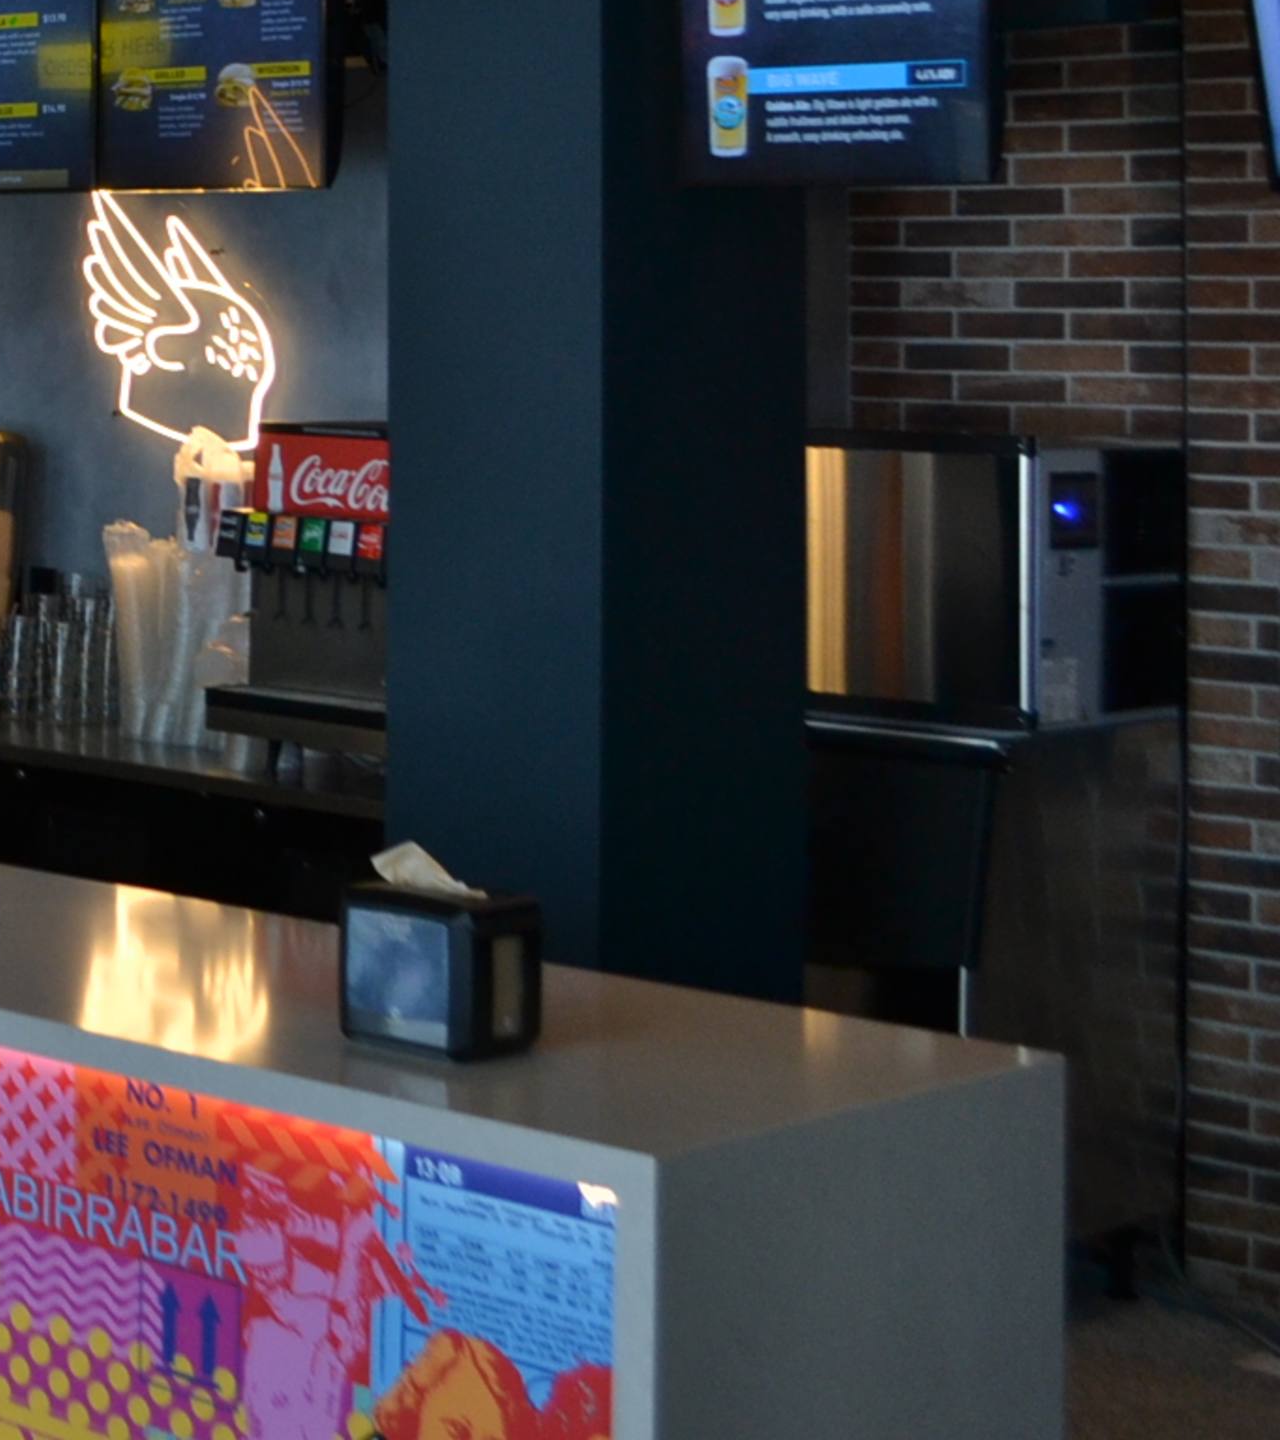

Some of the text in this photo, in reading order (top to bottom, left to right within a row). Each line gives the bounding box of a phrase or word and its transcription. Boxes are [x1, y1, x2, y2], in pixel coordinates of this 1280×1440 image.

[125, 1075, 198, 1120] NO. 1
[92, 1125, 129, 1158] LEE
[143, 1140, 239, 1186] OFMAN
